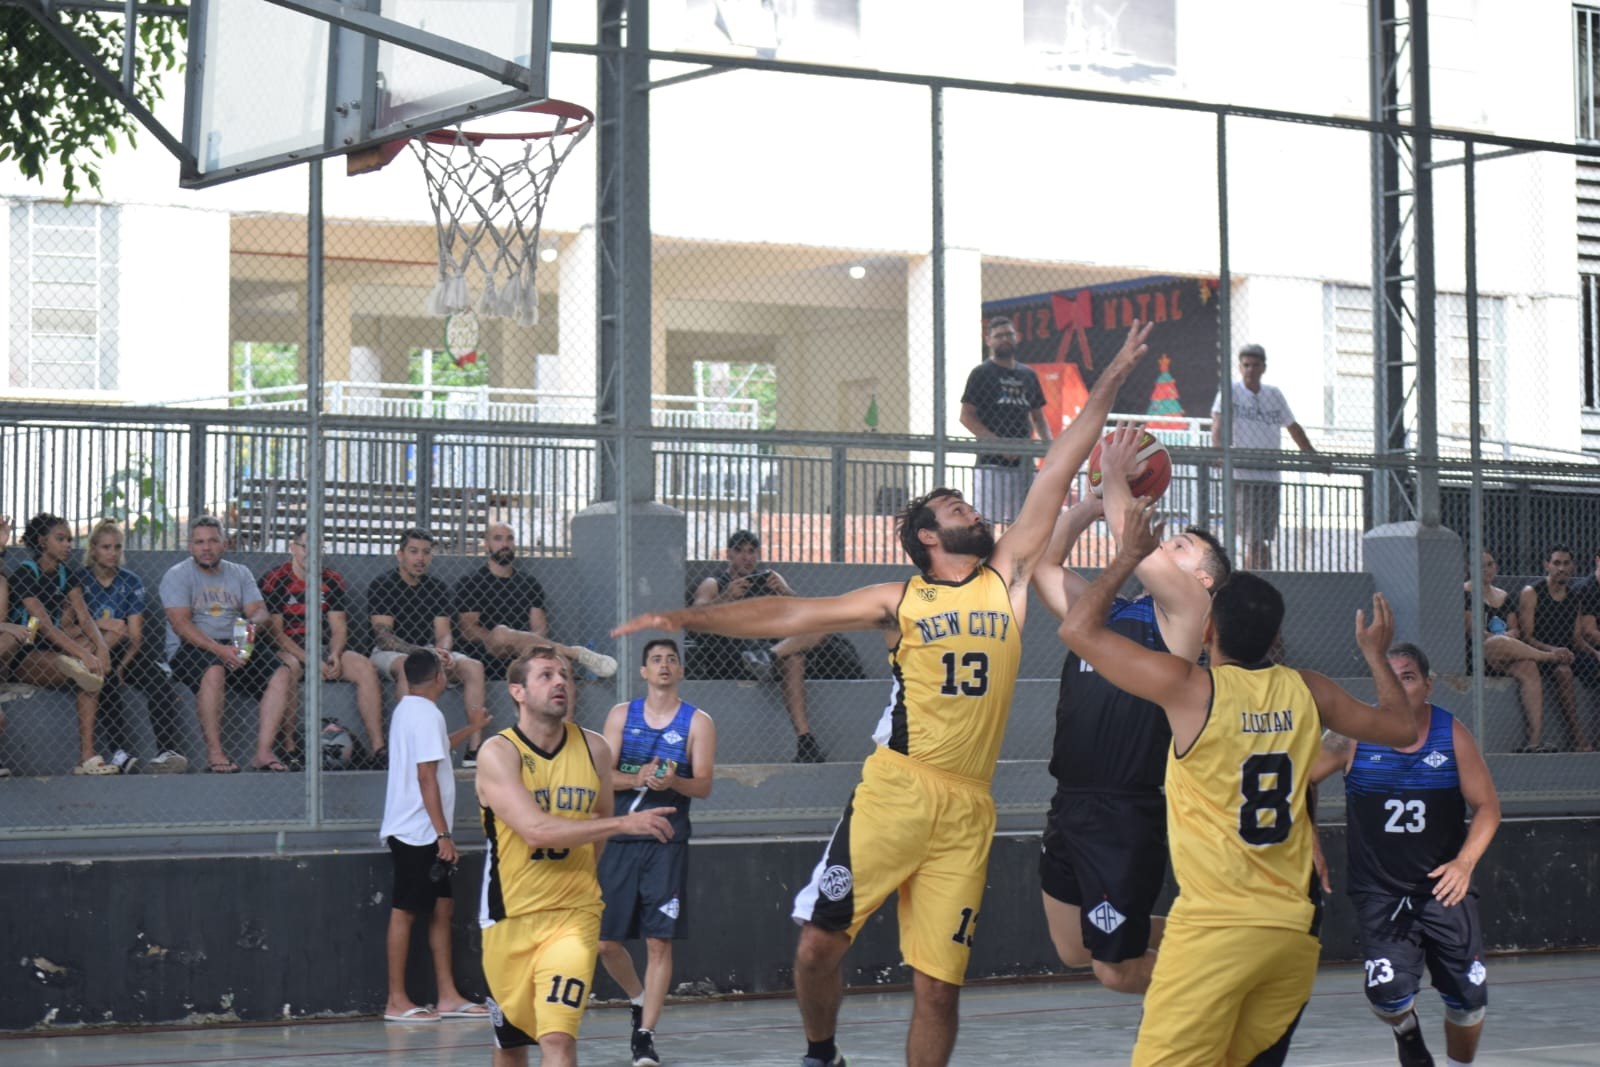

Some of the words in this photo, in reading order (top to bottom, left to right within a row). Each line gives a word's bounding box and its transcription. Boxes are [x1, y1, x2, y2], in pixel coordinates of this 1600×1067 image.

[1104, 290, 1183, 330] NATAL
[916, 612, 961, 643] NEW
[969, 611, 1010, 643] CITY
[941, 651, 989, 697] 13
[1241, 710, 1293, 733] LUCIAN
[557, 786, 597, 814] CITY
[1238, 751, 1293, 846] 8
[1383, 798, 1426, 834] 23
[1364, 957, 1395, 988] 23
[545, 974, 586, 1009] 10
